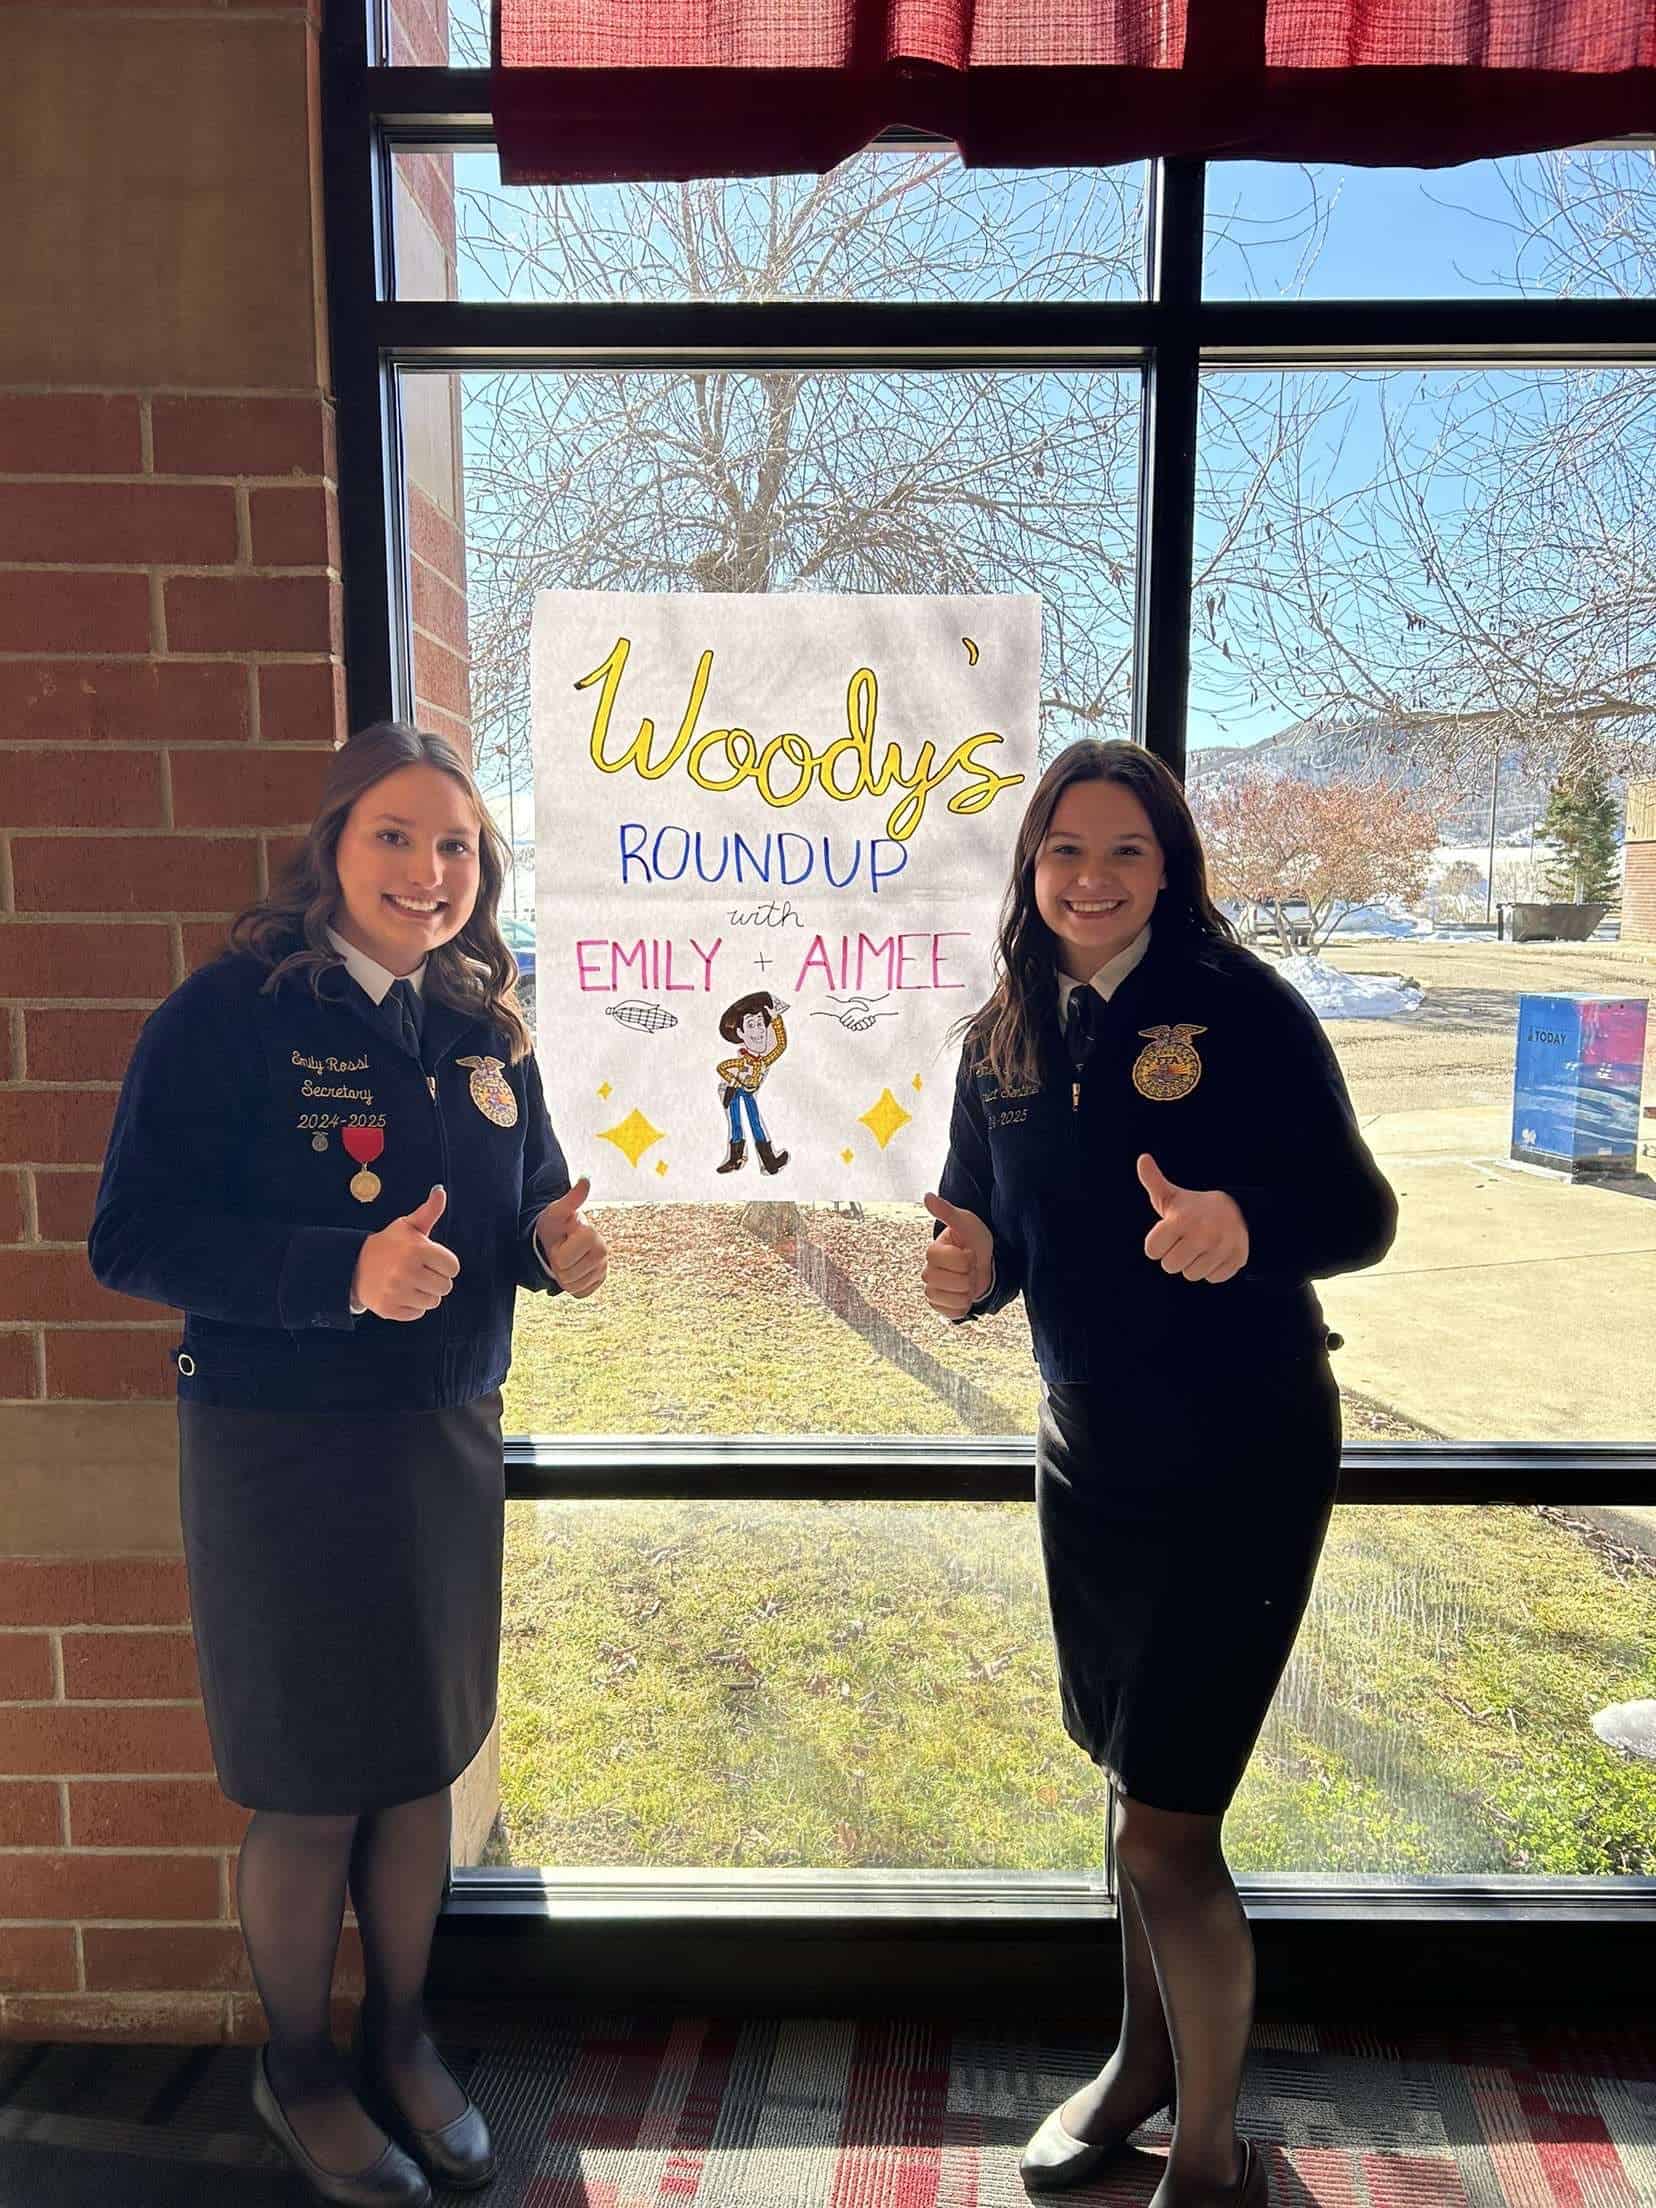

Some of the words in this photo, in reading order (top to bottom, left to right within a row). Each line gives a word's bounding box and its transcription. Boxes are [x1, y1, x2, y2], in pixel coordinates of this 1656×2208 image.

[574, 637, 1026, 842] Woody's
[618, 823, 909, 894] ROUNDUP
[726, 899, 805, 928] with
[575, 937, 722, 992] EMILY
[795, 932, 972, 992] AIMEE
[1536, 1031, 1566, 1046] TODAY
[301, 1080, 375, 1105] Secretary
[297, 1114, 387, 1129] 2024-2025
